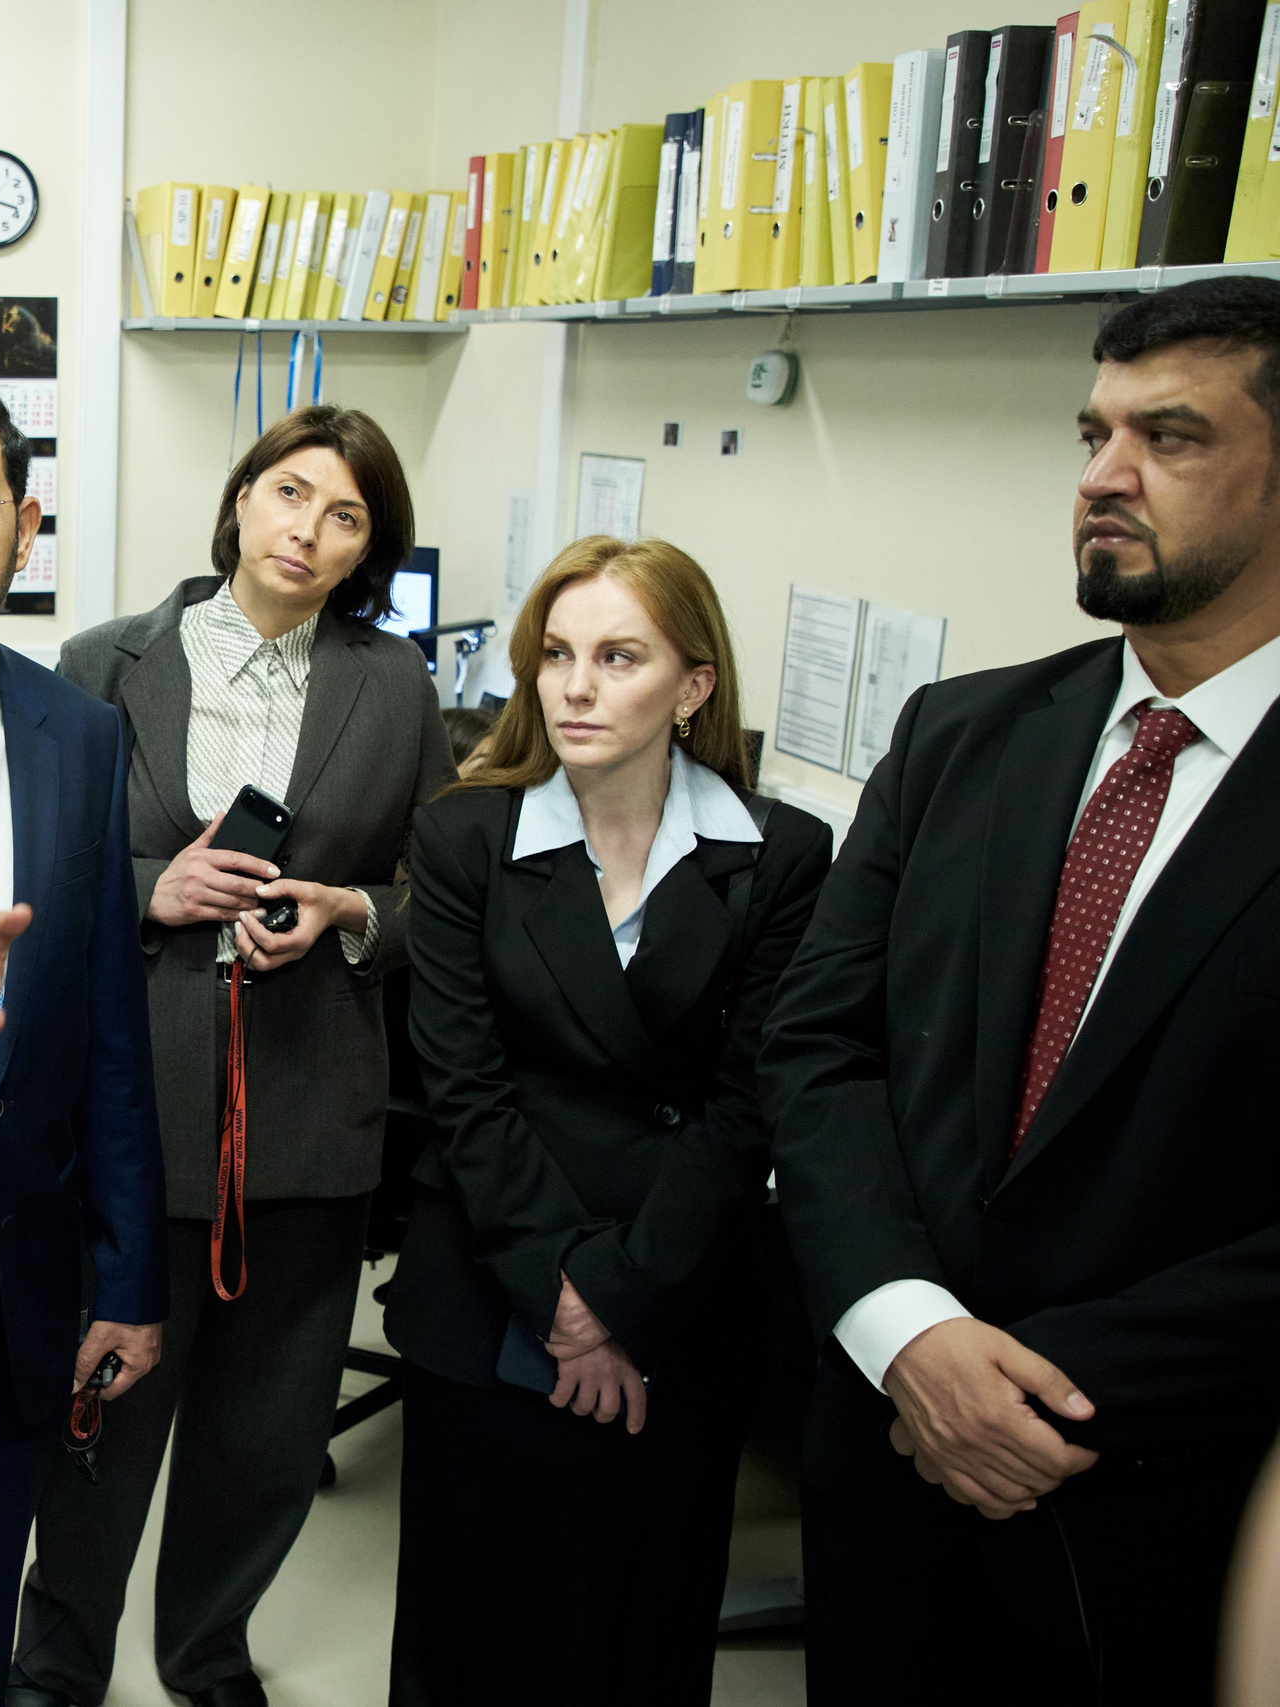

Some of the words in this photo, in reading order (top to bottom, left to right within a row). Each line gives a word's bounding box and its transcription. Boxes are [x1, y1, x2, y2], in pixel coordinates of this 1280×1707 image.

[778, 104, 792, 170] МЕТКИ
[5, 168, 10, 178] 1
[13, 179, 21, 188] 2
[17, 195, 25, 205] 3
[1, 221, 10, 232] 5
[235, 1108, 244, 1206] WWW.TOUR-AUDIO.RU
[213, 1151, 230, 1241] WWW.TOUR-AUDIO.RU
